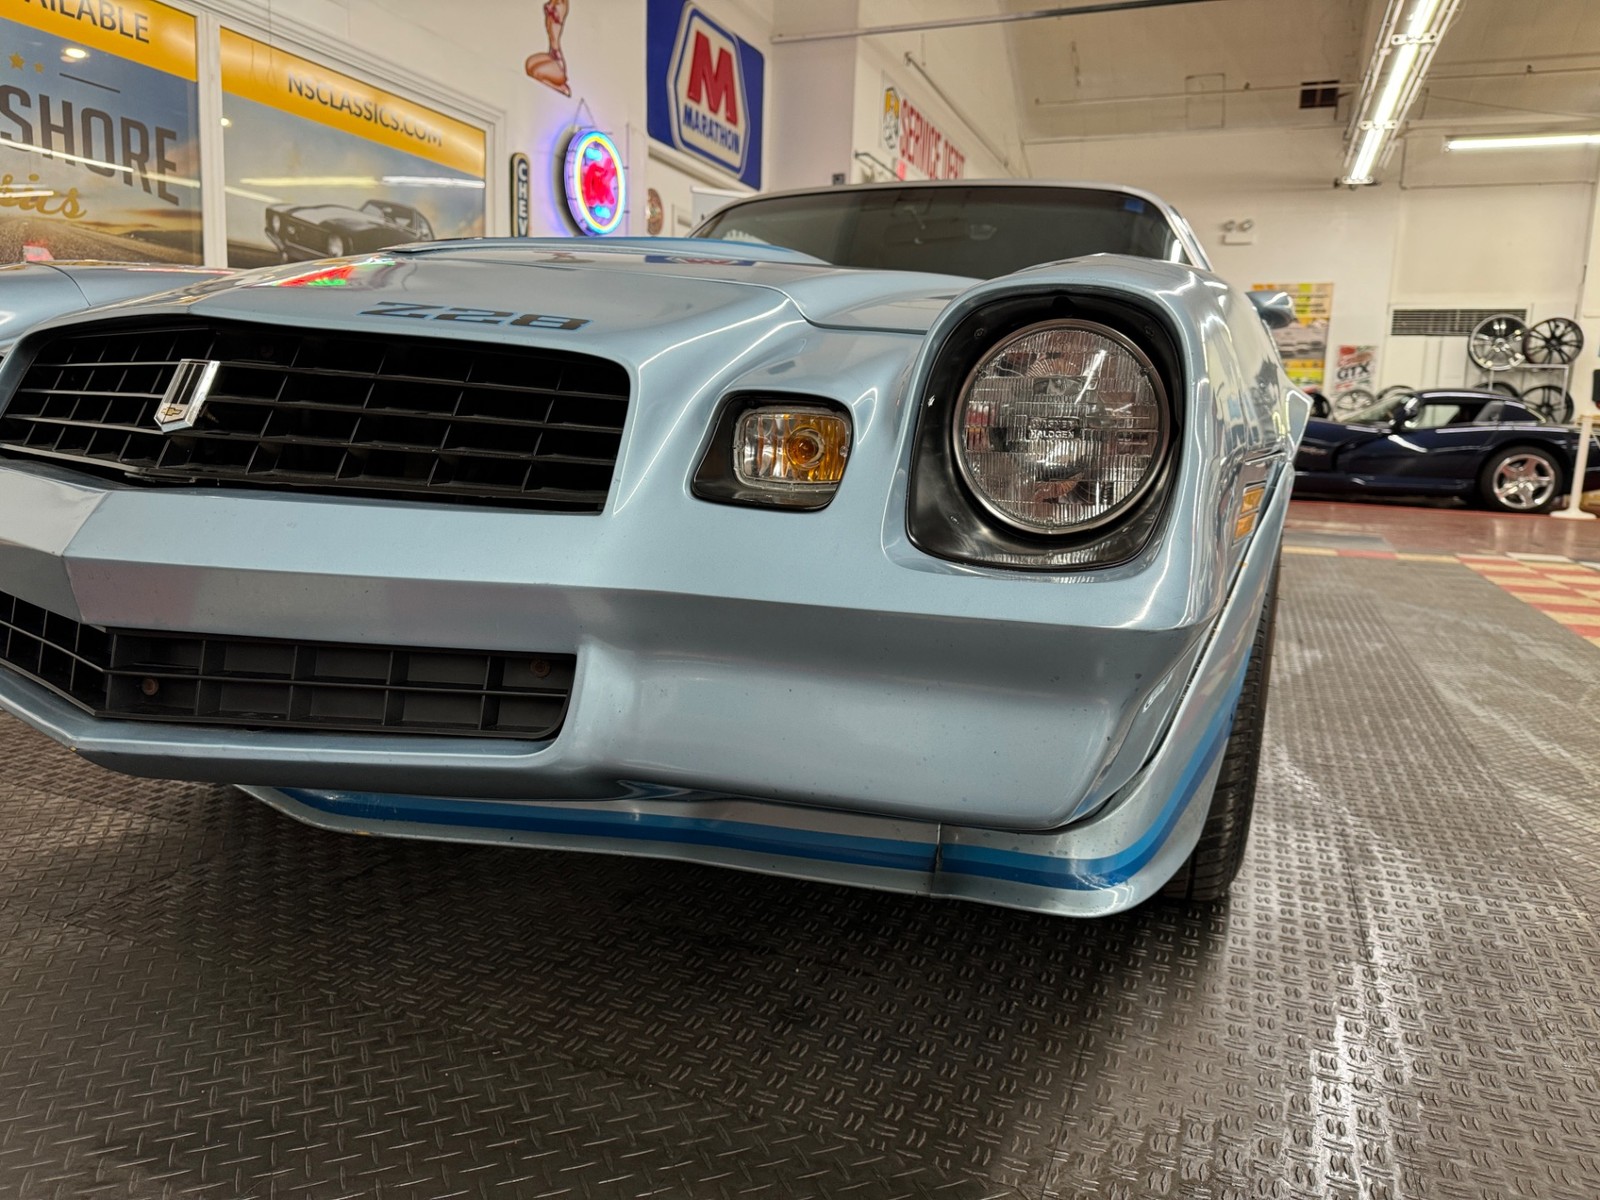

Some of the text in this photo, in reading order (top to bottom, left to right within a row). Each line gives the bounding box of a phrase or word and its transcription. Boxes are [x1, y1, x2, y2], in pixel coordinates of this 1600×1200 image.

[287, 71, 443, 147] NSCLASSICS.COM
[687, 29, 738, 127] M
[0, 84, 180, 207] SHORE
[682, 103, 740, 154] MARATHON
[899, 98, 942, 180] SERVICE
[517, 158, 530, 238] CHEV
[358, 300, 592, 331] Z28
[1337, 360, 1371, 381] GTX
[1030, 429, 1075, 439] HALOGEN
